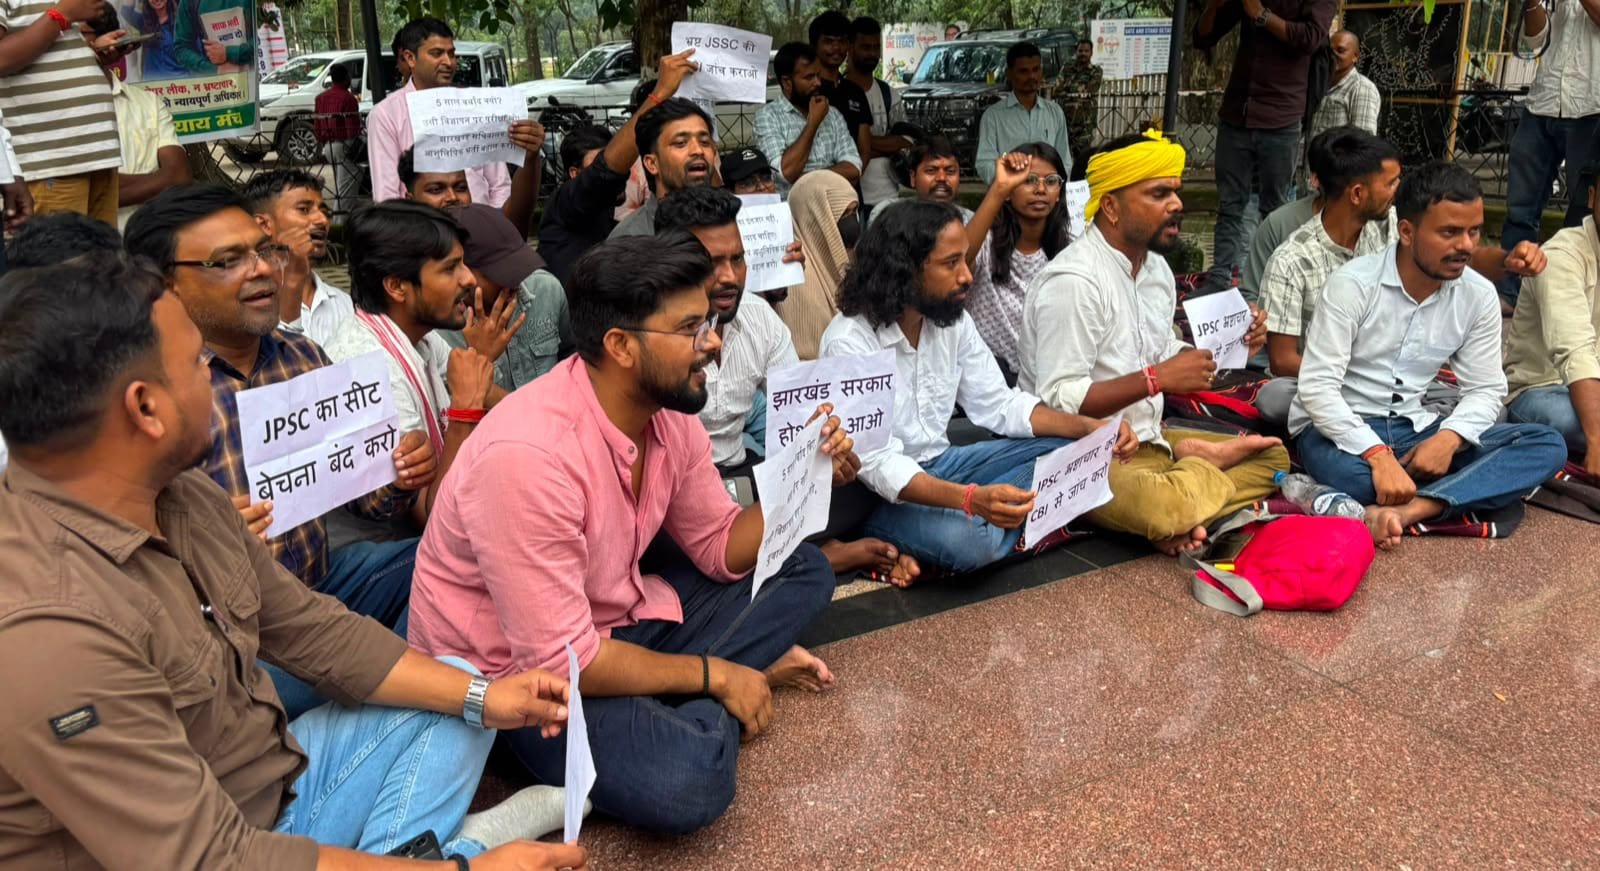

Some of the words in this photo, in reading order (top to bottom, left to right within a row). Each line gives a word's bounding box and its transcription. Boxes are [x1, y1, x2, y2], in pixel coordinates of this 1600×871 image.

[704, 36, 739, 50] JSSC
[742, 40, 756, 53] की
[729, 65, 759, 80] कराओ
[192, 84, 201, 92] न
[174, 92, 211, 107] न्यायपूर्ण
[436, 98, 442, 107] 5
[215, 110, 243, 127] मंच
[472, 115, 482, 125] पर
[1198, 319, 1220, 337] JPSC
[772, 378, 832, 412] झारखंड
[840, 373, 894, 398] सरकार
[263, 407, 311, 444] JPSC
[315, 395, 338, 422] का
[342, 380, 383, 413] सीट
[846, 408, 884, 434] आओ
[256, 461, 317, 501] बेचना
[328, 443, 355, 473] बंद
[364, 424, 397, 458] करो
[1037, 470, 1062, 493] JPSC
[1031, 504, 1049, 522] CBI
[1054, 491, 1064, 509] से
[1091, 461, 1109, 484] करो
